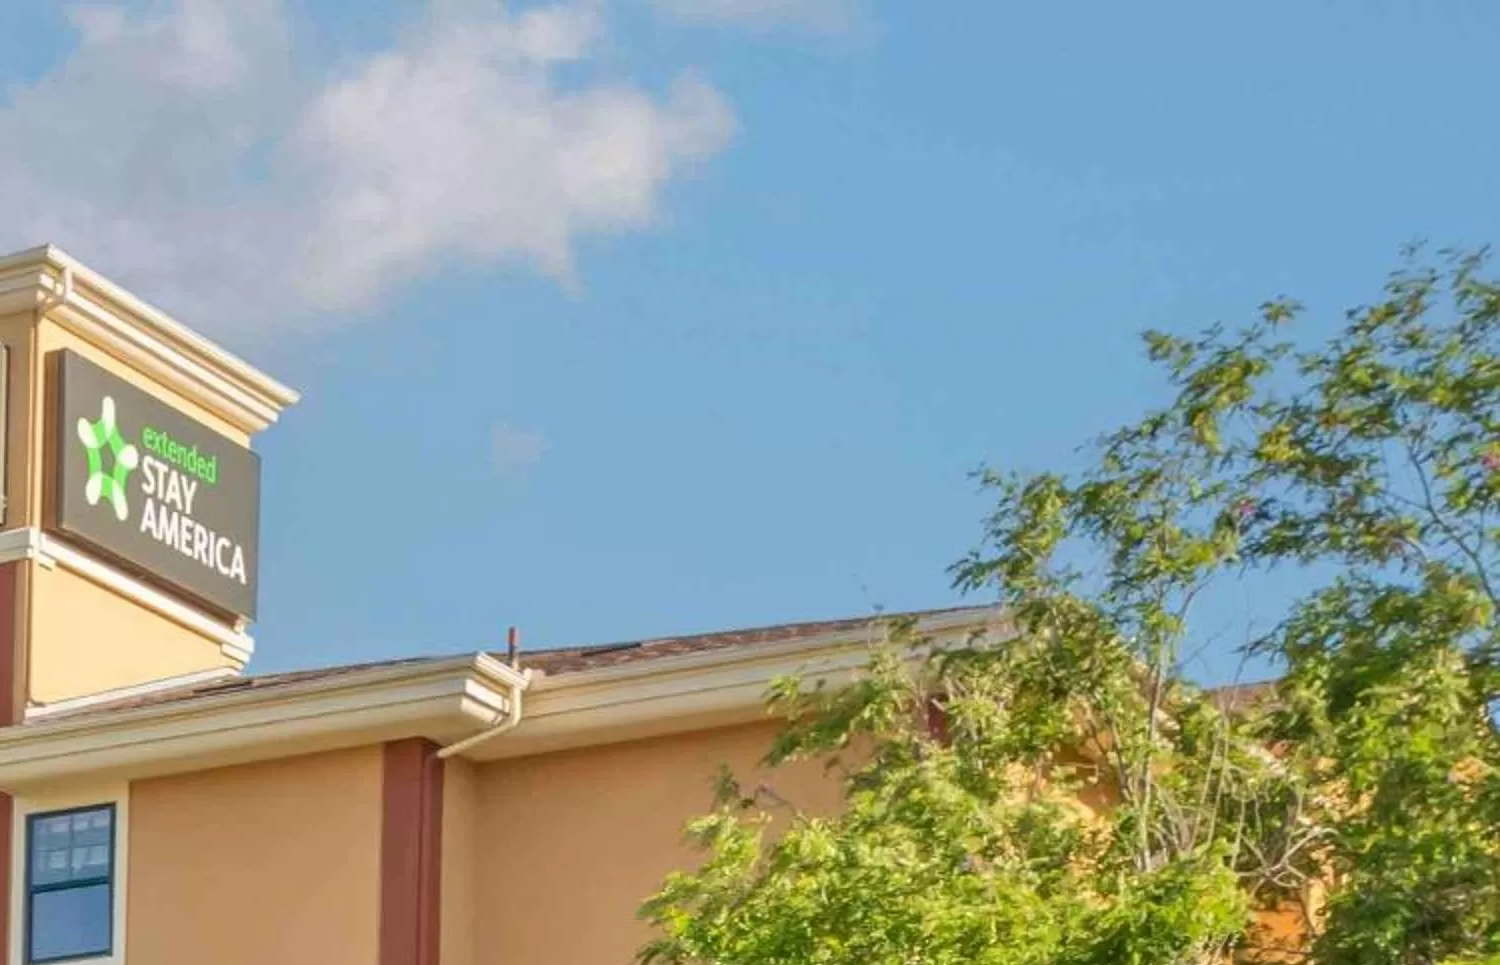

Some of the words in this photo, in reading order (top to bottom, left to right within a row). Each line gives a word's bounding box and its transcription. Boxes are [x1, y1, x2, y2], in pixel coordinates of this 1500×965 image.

[141, 455, 197, 514] STAY
[142, 427, 217, 484] extended
[140, 498, 247, 585] AMERICA
